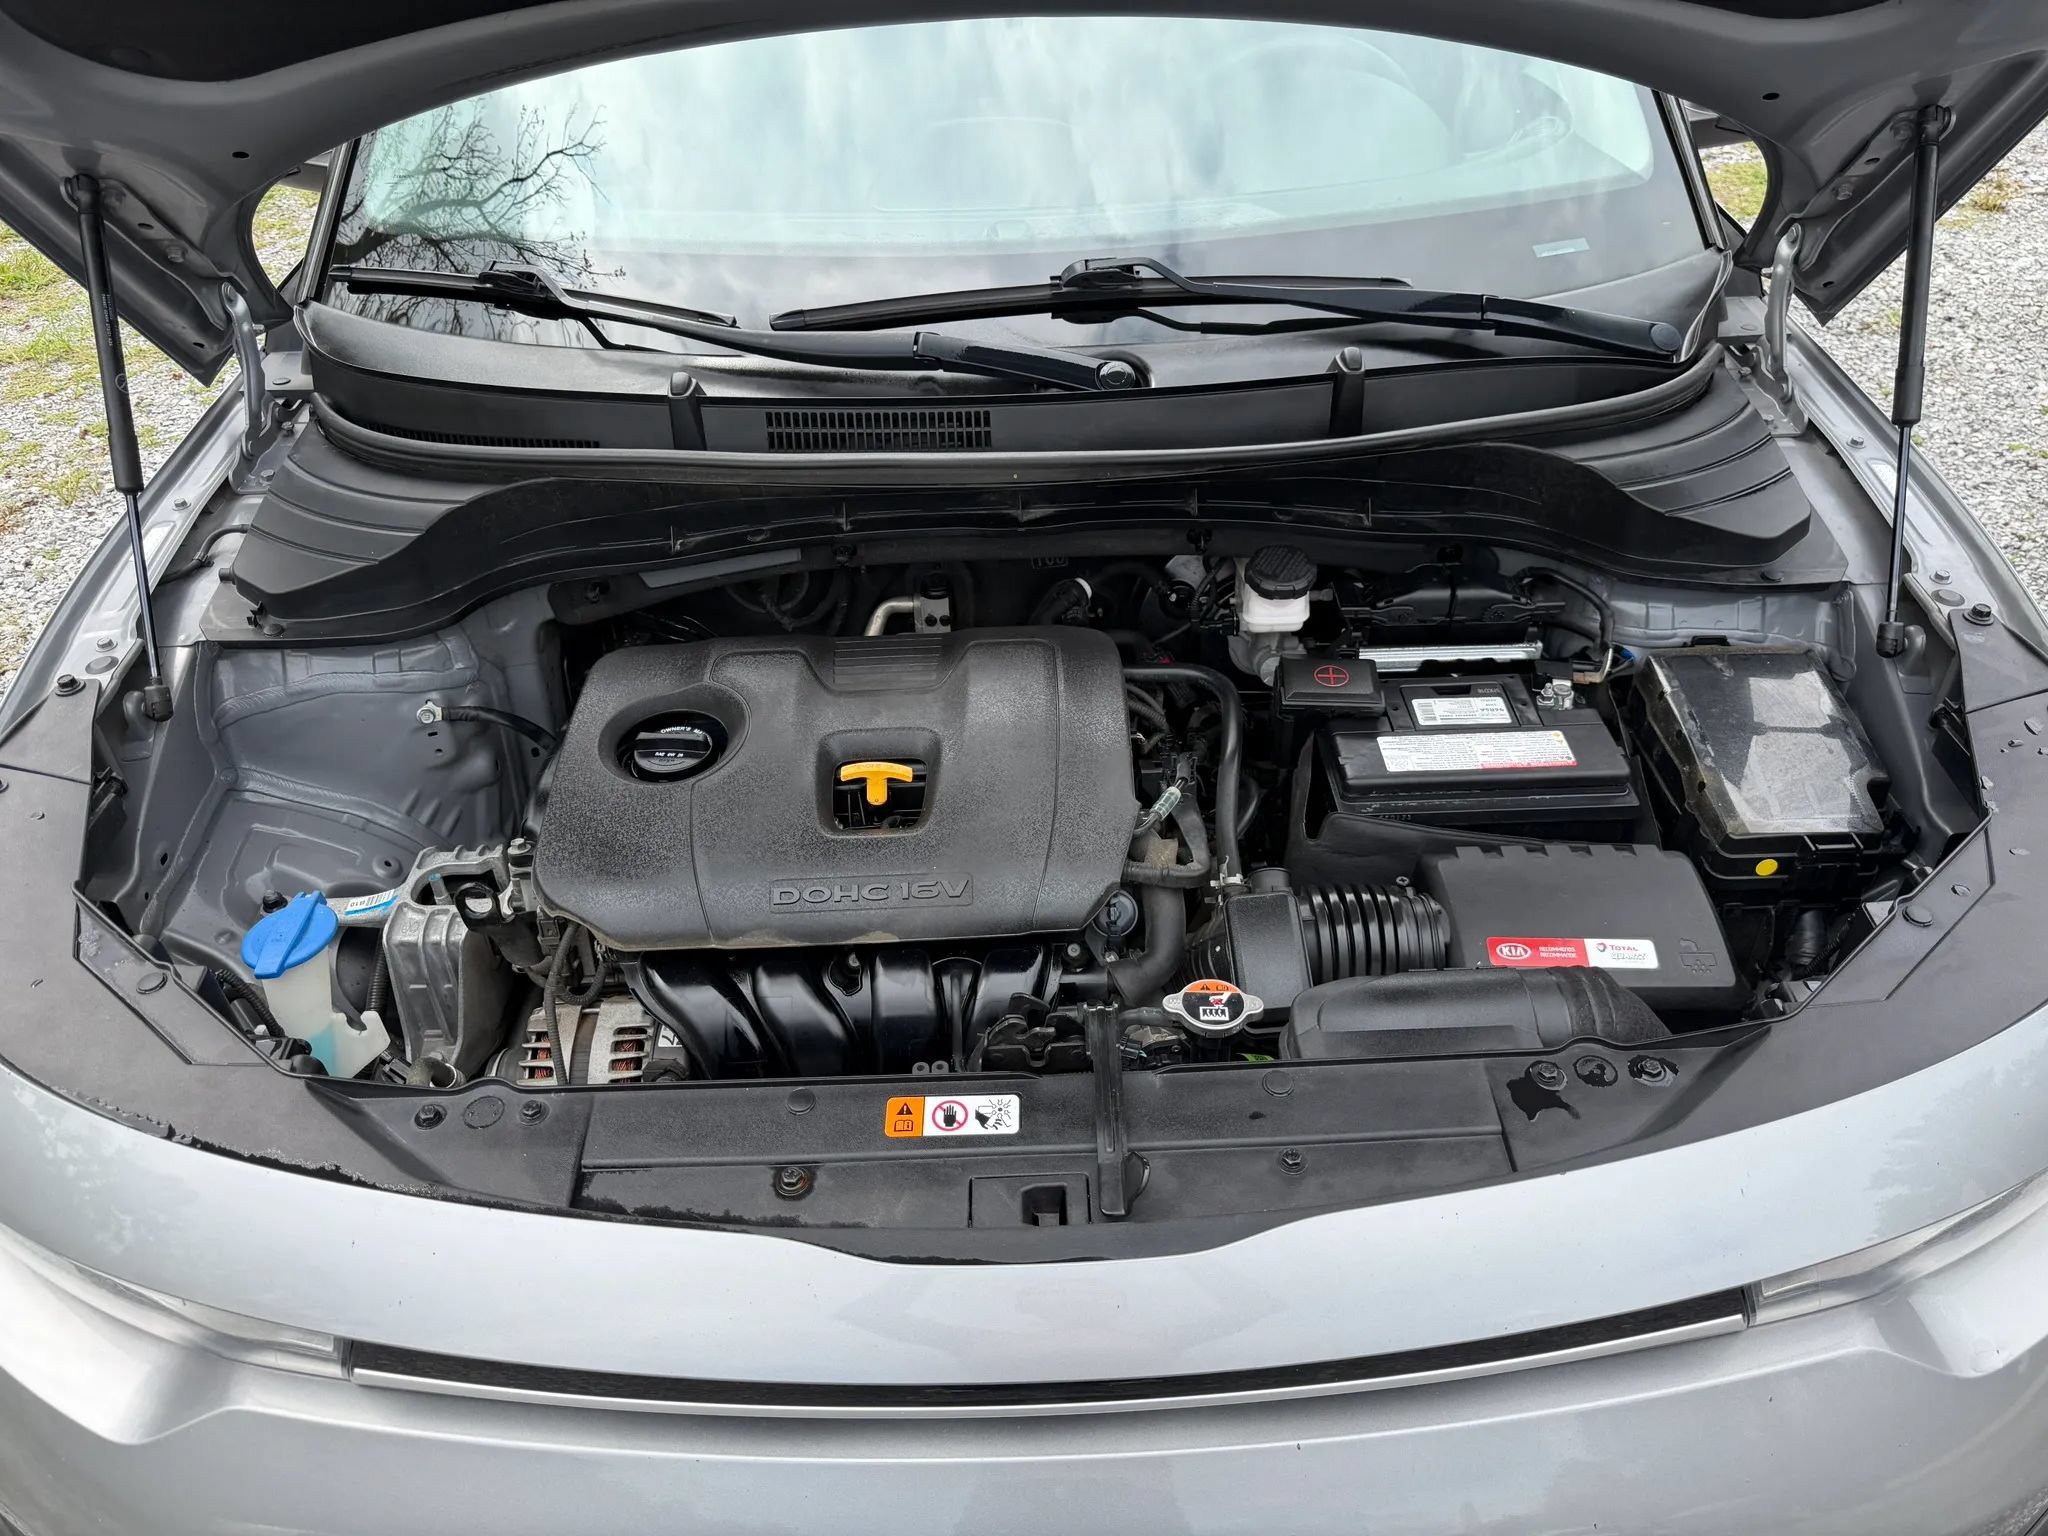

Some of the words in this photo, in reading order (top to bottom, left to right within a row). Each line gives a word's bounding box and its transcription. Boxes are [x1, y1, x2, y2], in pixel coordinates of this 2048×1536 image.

[660, 726, 692, 734] OWNER'S
[773, 884, 889, 906] DOHC
[900, 879, 969, 900] 16V
[1609, 944, 1639, 952] TOTAL
